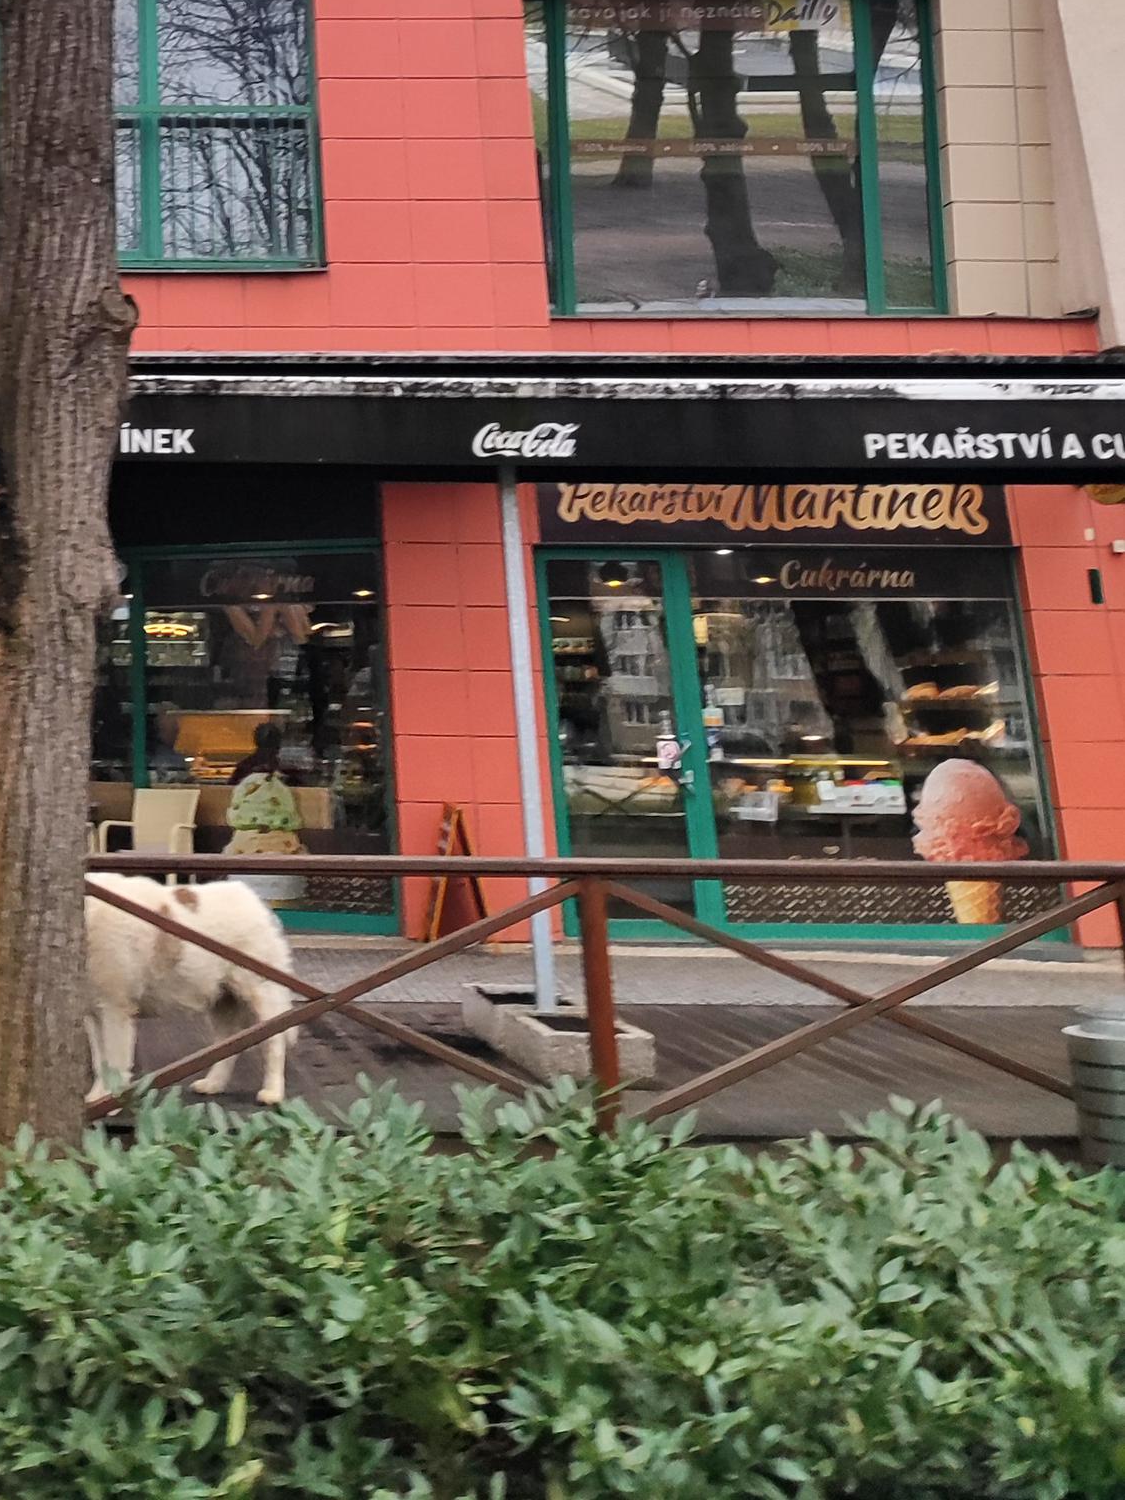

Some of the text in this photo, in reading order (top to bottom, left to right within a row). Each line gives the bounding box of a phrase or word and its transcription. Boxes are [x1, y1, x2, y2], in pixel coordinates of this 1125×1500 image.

[863, 426, 1053, 460] PEKAŘSTVÍ
[1061, 432, 1086, 460] A
[779, 560, 916, 590] Cukrárna
